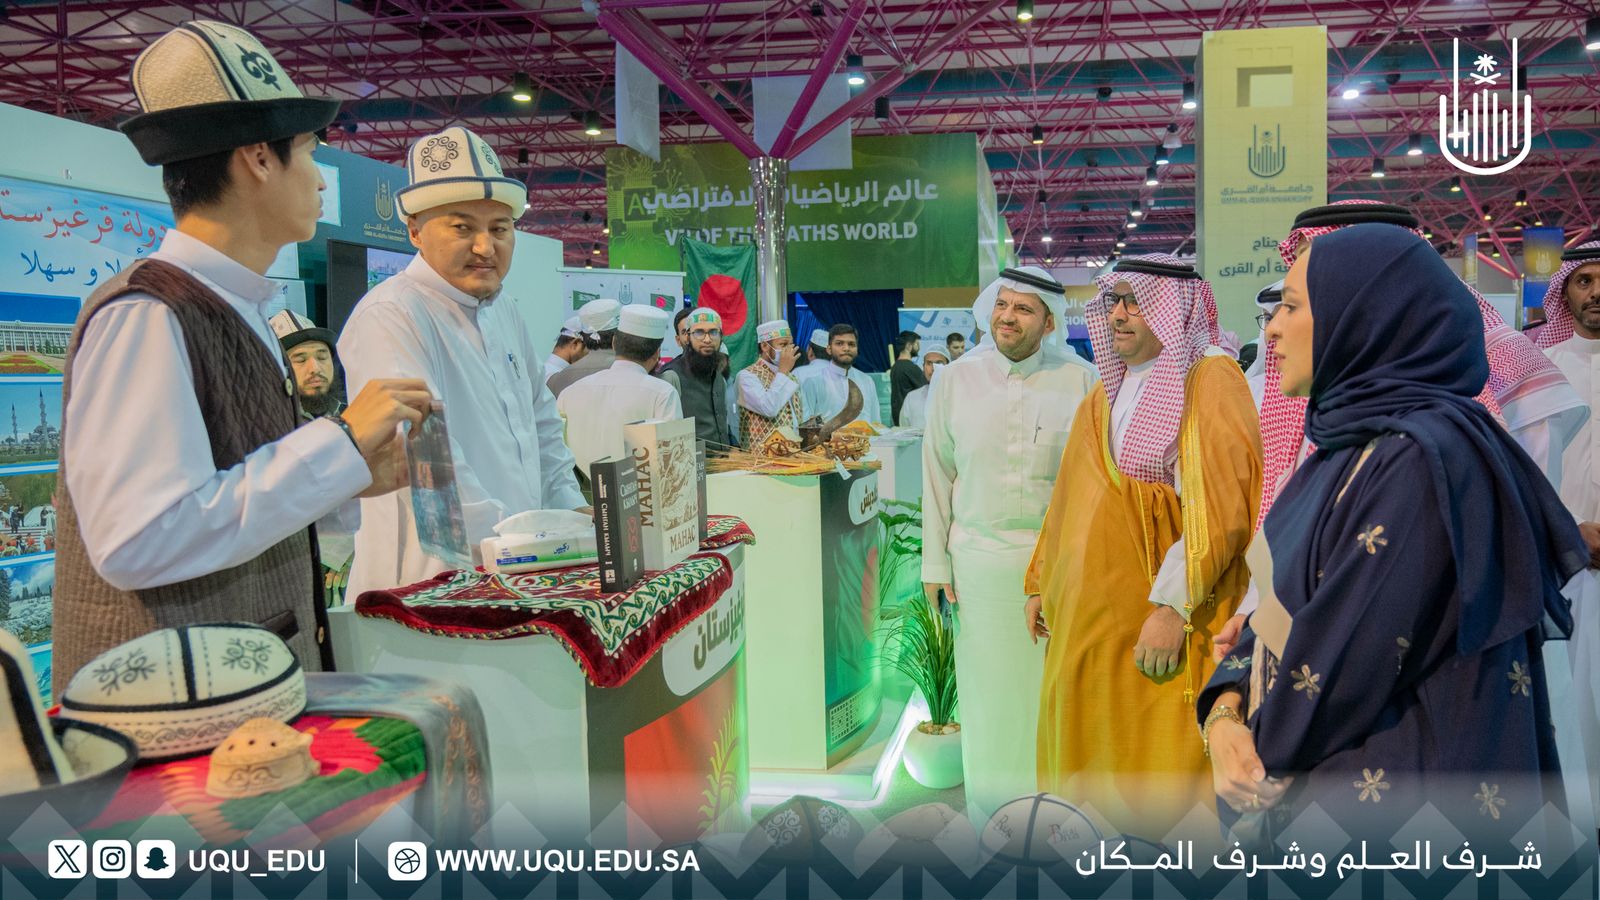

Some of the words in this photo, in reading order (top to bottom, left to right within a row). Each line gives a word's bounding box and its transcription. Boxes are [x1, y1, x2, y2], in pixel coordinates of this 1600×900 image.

[642, 184, 753, 214] لافتراضي
[785, 180, 878, 209] الرياضيا
[883, 179, 938, 207] عالم
[727, 226, 751, 244] TH
[786, 224, 839, 242] ATHS
[843, 221, 918, 241] WORLD
[1252, 236, 1279, 251] جناح
[20, 250, 75, 283] سهلا
[83, 267, 98, 286] و
[1219, 262, 1253, 277] القرى
[1256, 257, 1271, 276] أم
